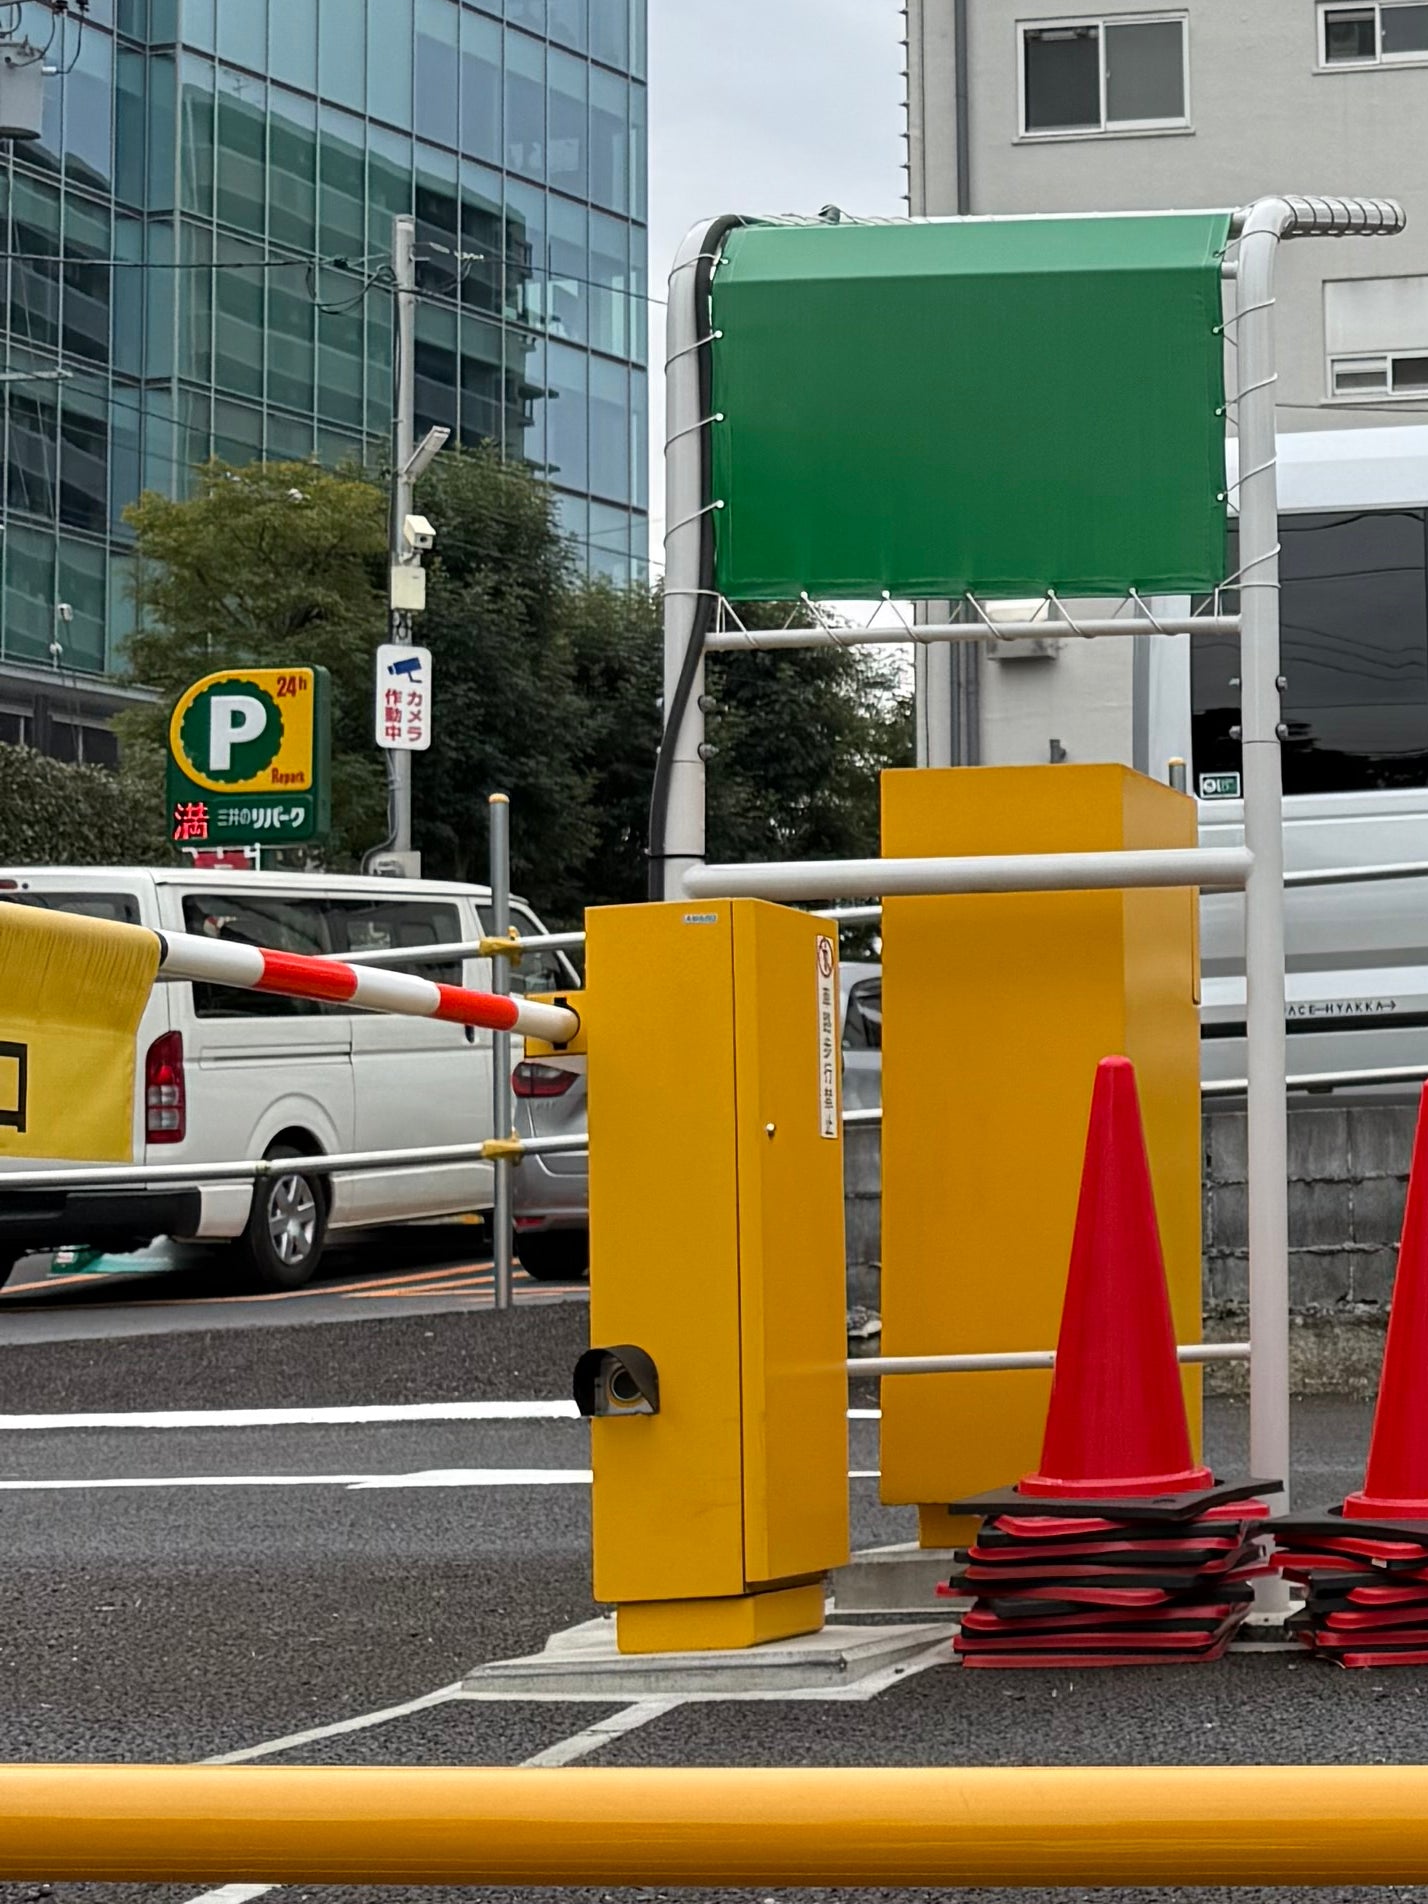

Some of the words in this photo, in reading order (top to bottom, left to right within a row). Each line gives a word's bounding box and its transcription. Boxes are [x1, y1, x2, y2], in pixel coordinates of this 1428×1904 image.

[276, 676, 307, 698] 24h
[209, 696, 267, 771] P
[385, 687, 402, 742] 作動中
[406, 690, 423, 742] カメラ
[271, 768, 305, 785] Repark
[173, 801, 209, 841] 満
[217, 807, 306, 829] 三井のリパーク
